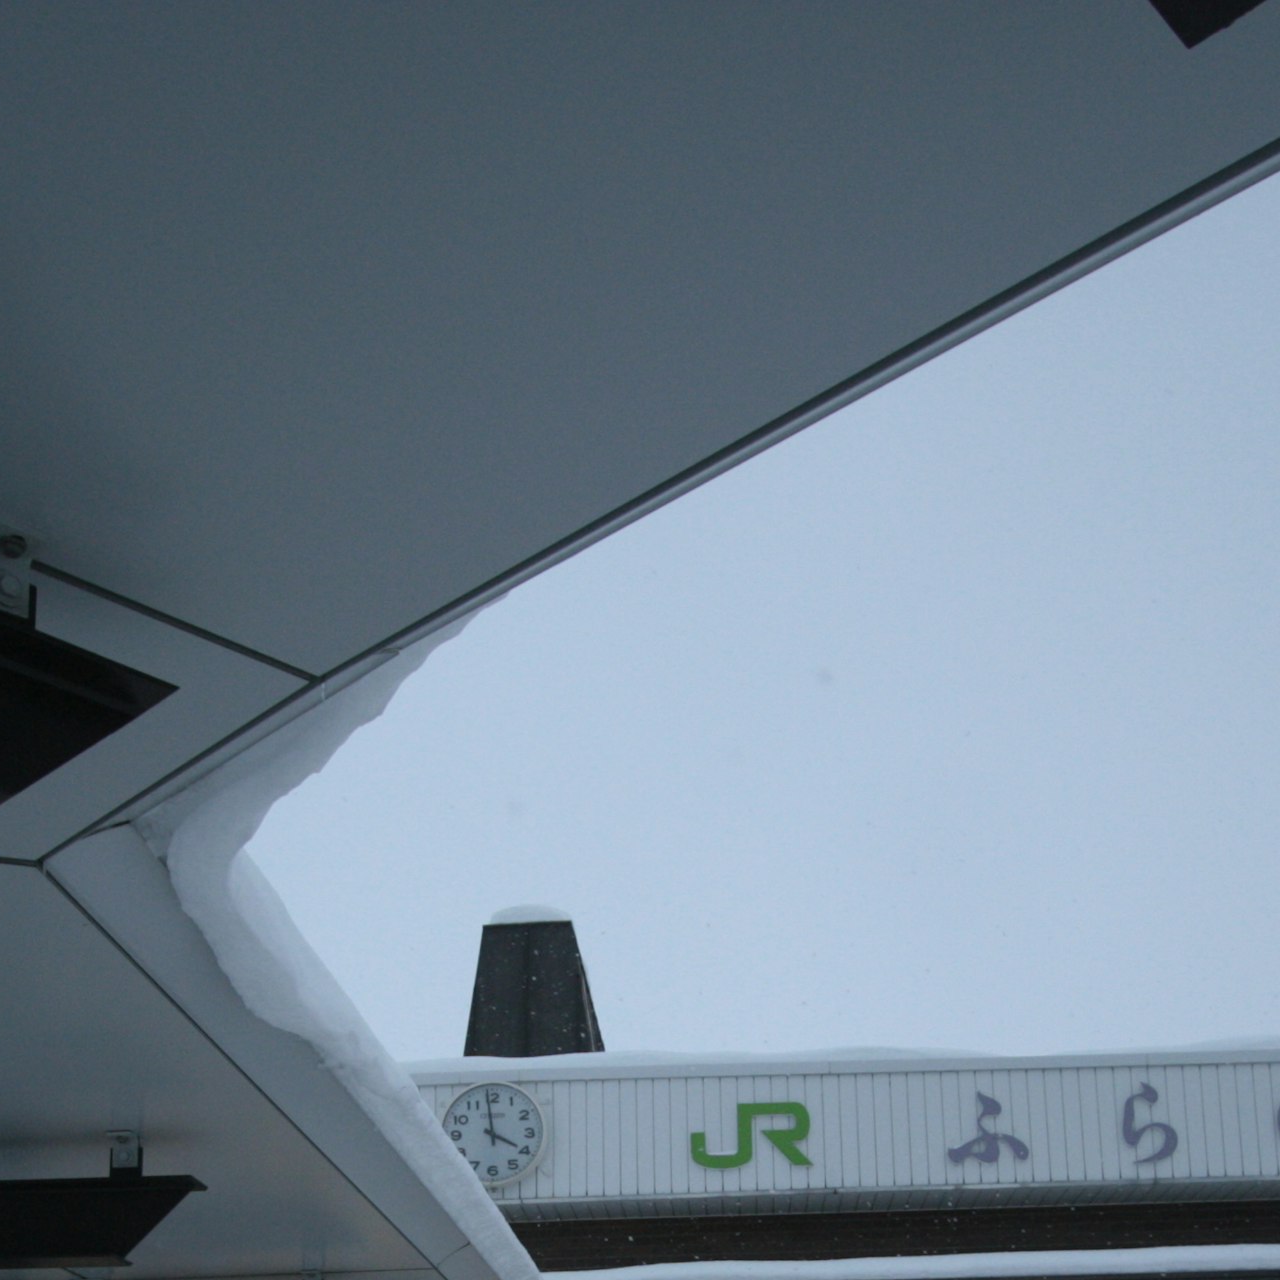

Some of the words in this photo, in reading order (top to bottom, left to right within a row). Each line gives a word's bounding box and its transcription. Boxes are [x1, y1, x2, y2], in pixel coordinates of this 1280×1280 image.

[467, 1100, 479, 1111] 11
[453, 1115, 469, 1126] 10
[519, 1110, 530, 1121] 2
[451, 1130, 462, 1141] 9
[524, 1128, 535, 1139] 3
[690, 1102, 814, 1169] JR
[518, 1145, 531, 1156] 4
[487, 1165, 498, 1177] 6
[507, 1160, 519, 1171] 5
